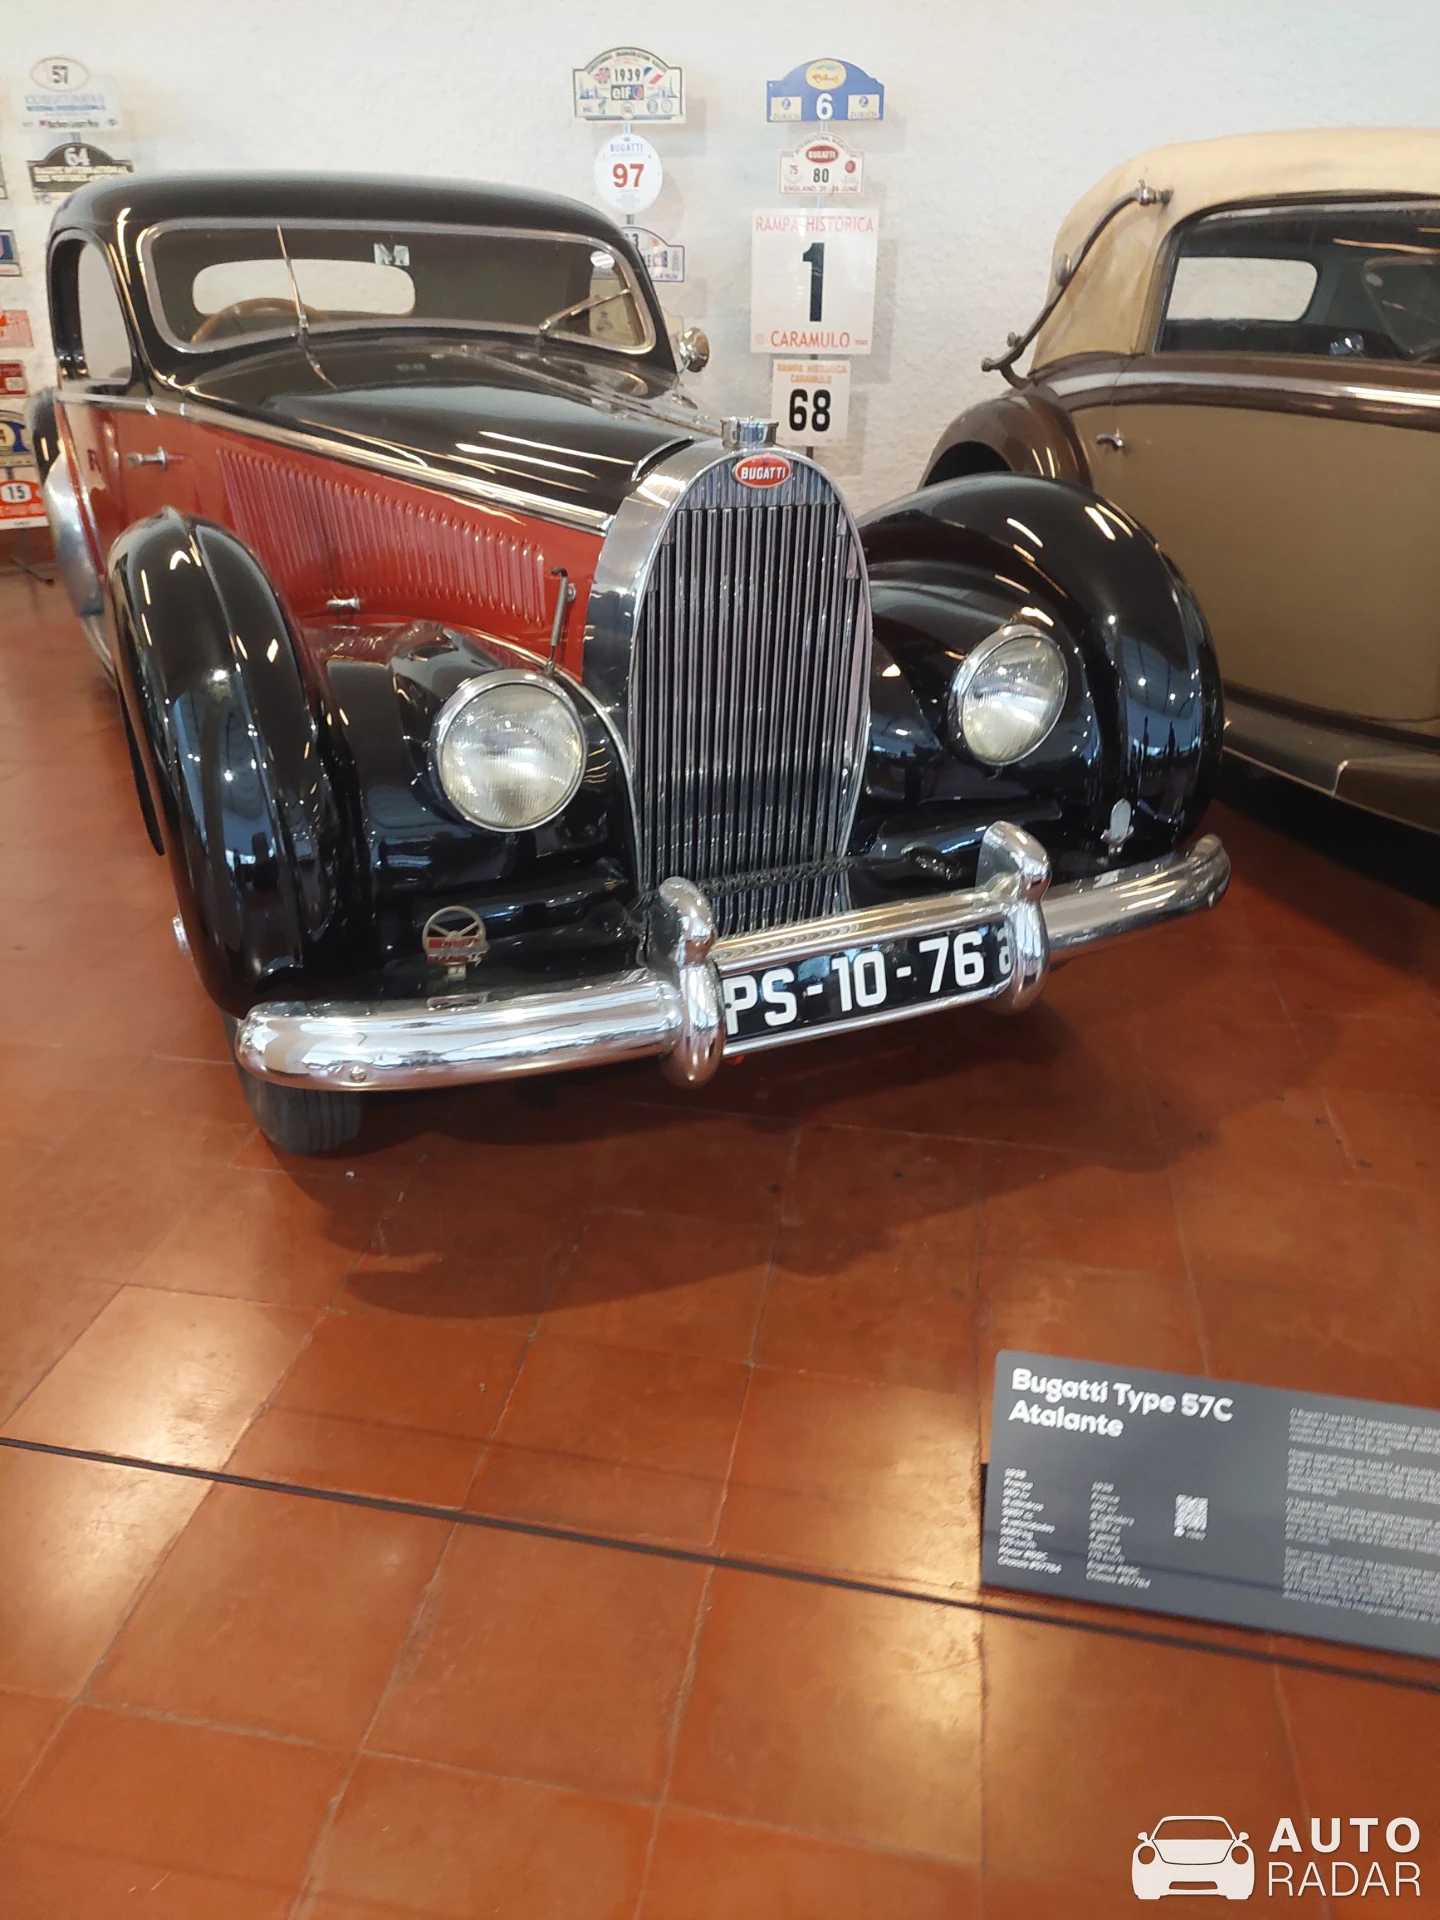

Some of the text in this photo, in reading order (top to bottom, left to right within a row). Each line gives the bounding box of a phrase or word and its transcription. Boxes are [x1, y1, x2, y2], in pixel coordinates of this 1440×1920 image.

[614, 68, 641, 82] 1939
[612, 86, 632, 99] elf
[816, 92, 834, 120] 6
[610, 143, 643, 152] BUGATTI
[612, 163, 645, 188] 97
[813, 168, 829, 183] 80
[755, 216, 798, 231] RAMPA
[802, 242, 825, 322] 1
[770, 330, 851, 348] CARAMULO
[789, 388, 831, 432] 68
[741, 467, 786, 480] BUGATTI
[8, 485, 26, 500] 15
[1011, 1367, 1234, 1422] Bugatti Type 57C
[1008, 1399, 1124, 1437] Atalante
